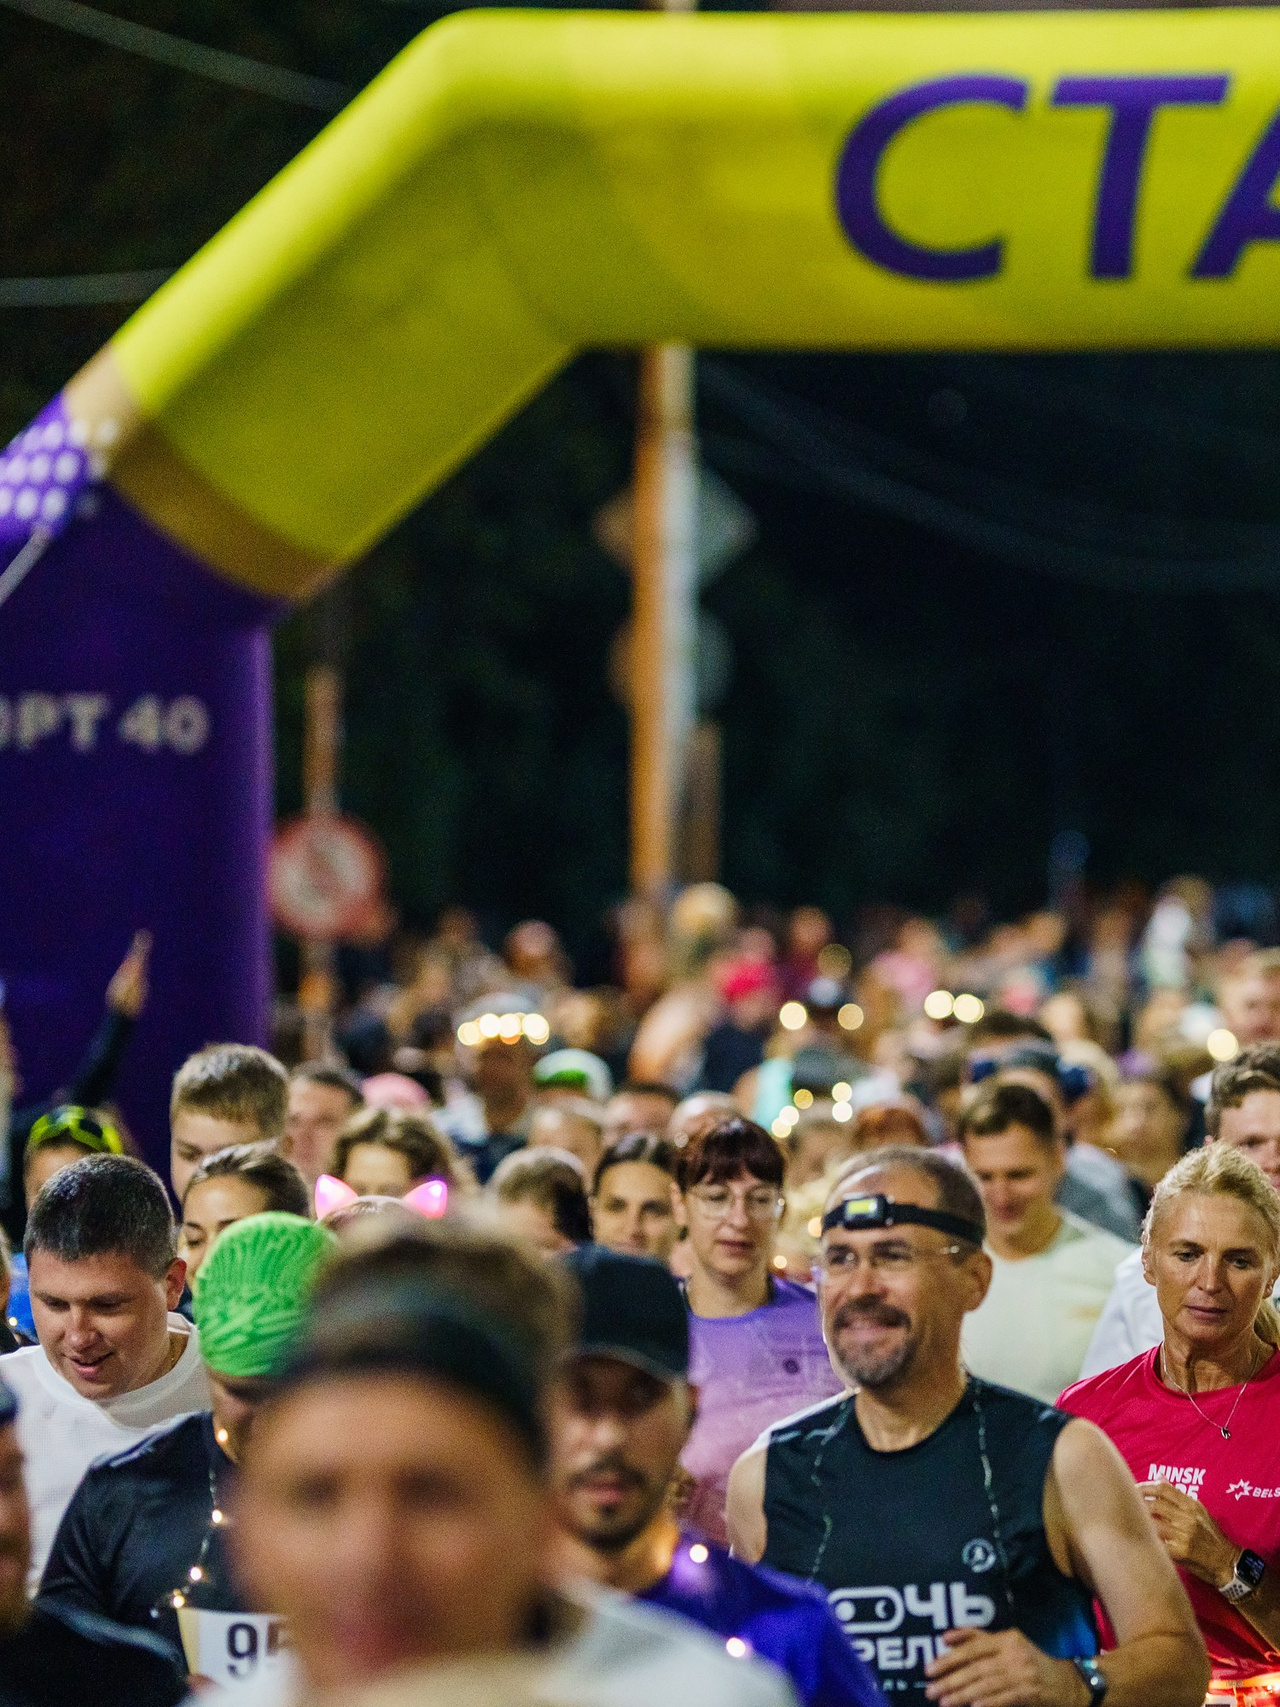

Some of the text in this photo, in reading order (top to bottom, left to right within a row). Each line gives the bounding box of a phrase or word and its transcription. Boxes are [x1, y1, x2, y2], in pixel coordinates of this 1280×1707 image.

[0, 693, 208, 753] РТ 40
[1148, 1463, 1207, 1486] MINSK
